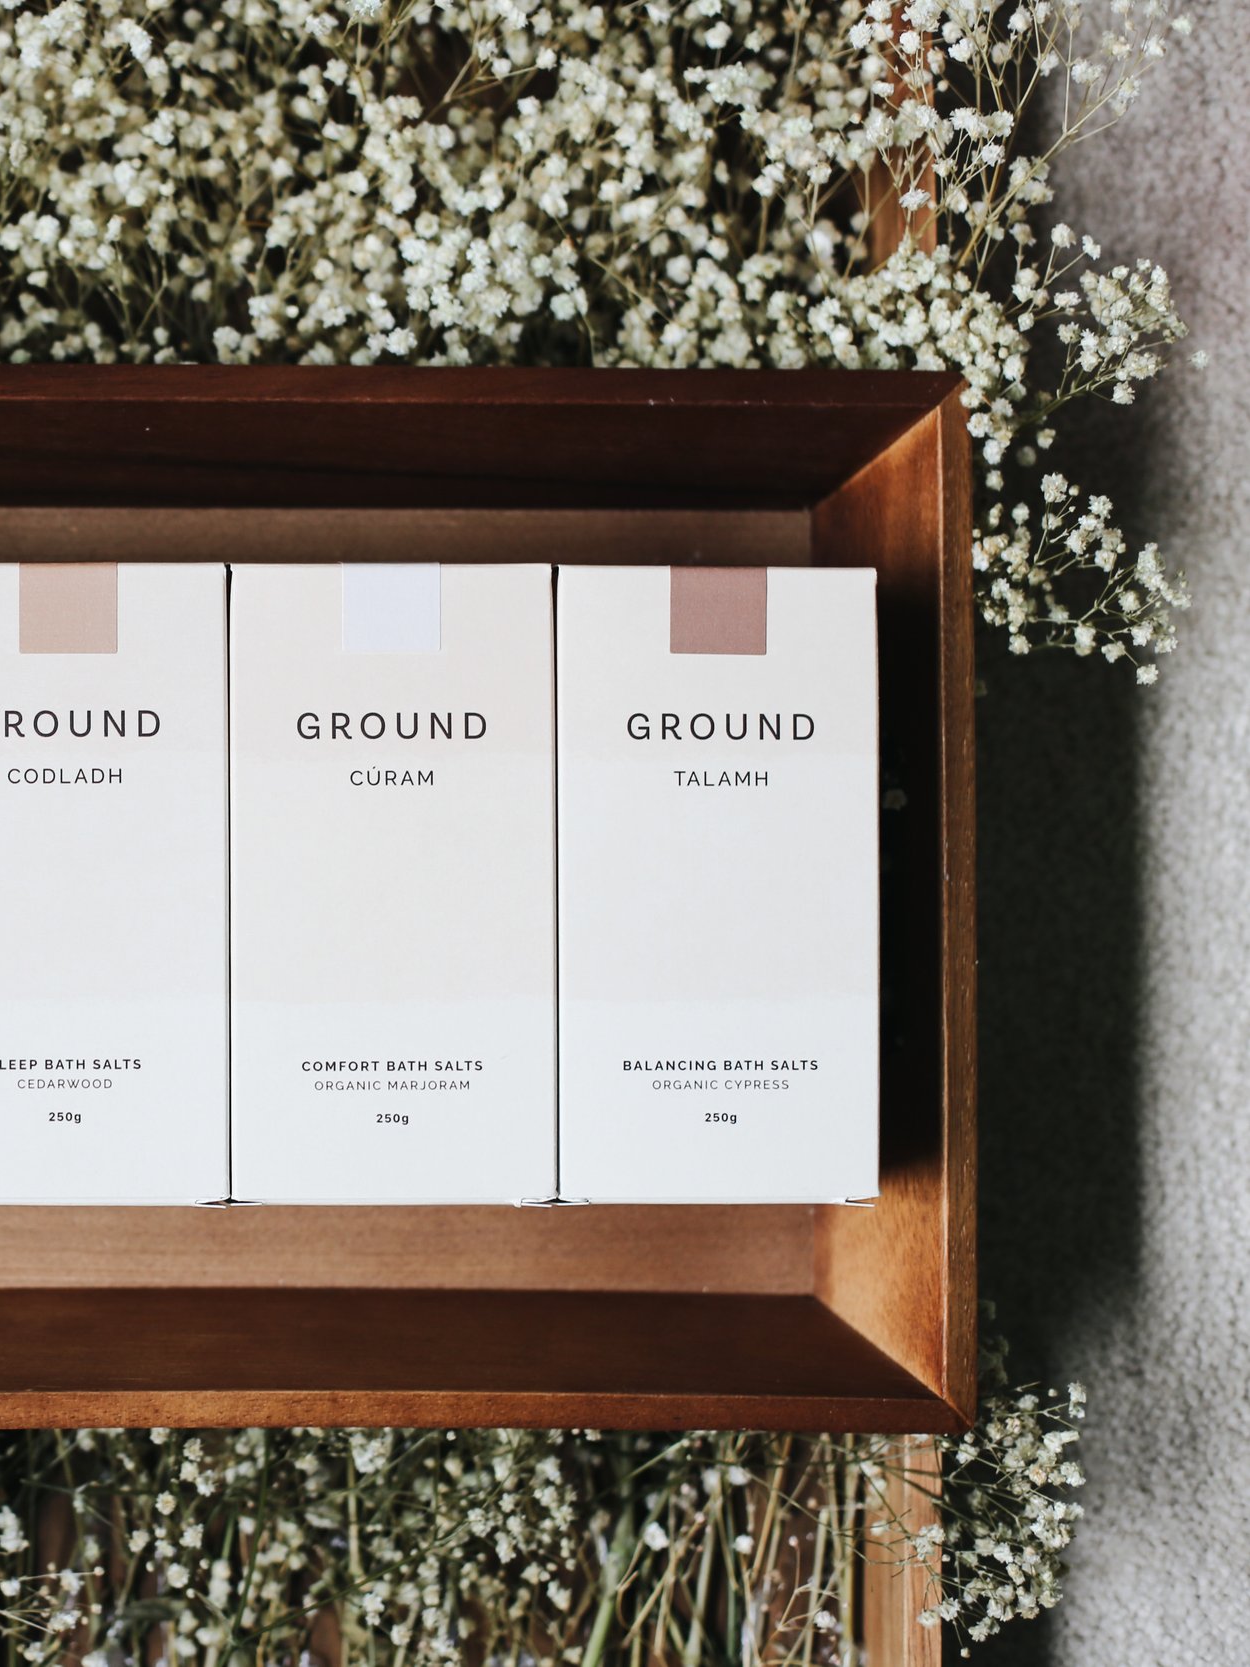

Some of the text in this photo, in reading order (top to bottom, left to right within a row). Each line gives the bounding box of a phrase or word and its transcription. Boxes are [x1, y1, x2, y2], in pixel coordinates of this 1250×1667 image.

[296, 710, 487, 740] GROUND
[626, 711, 815, 741] GROUND
[7, 767, 123, 785] CODLADH
[349, 765, 434, 787] CÚRAM
[673, 770, 769, 787] TALAMH
[44, 1058, 86, 1071] BATH
[92, 1058, 142, 1071] SALTS
[301, 1060, 483, 1072] COMFORT BATH SALTS
[622, 1059, 819, 1072] BALANCING BATH SALTS
[17, 1078, 113, 1090] CEDARWOOD
[314, 1080, 470, 1091] ORGANIC MARJORAM
[651, 1079, 790, 1091] ORGANIC CYPRESS
[48, 1111, 82, 1125] 250g
[375, 1113, 409, 1126] 250g
[704, 1112, 738, 1125] 250g
